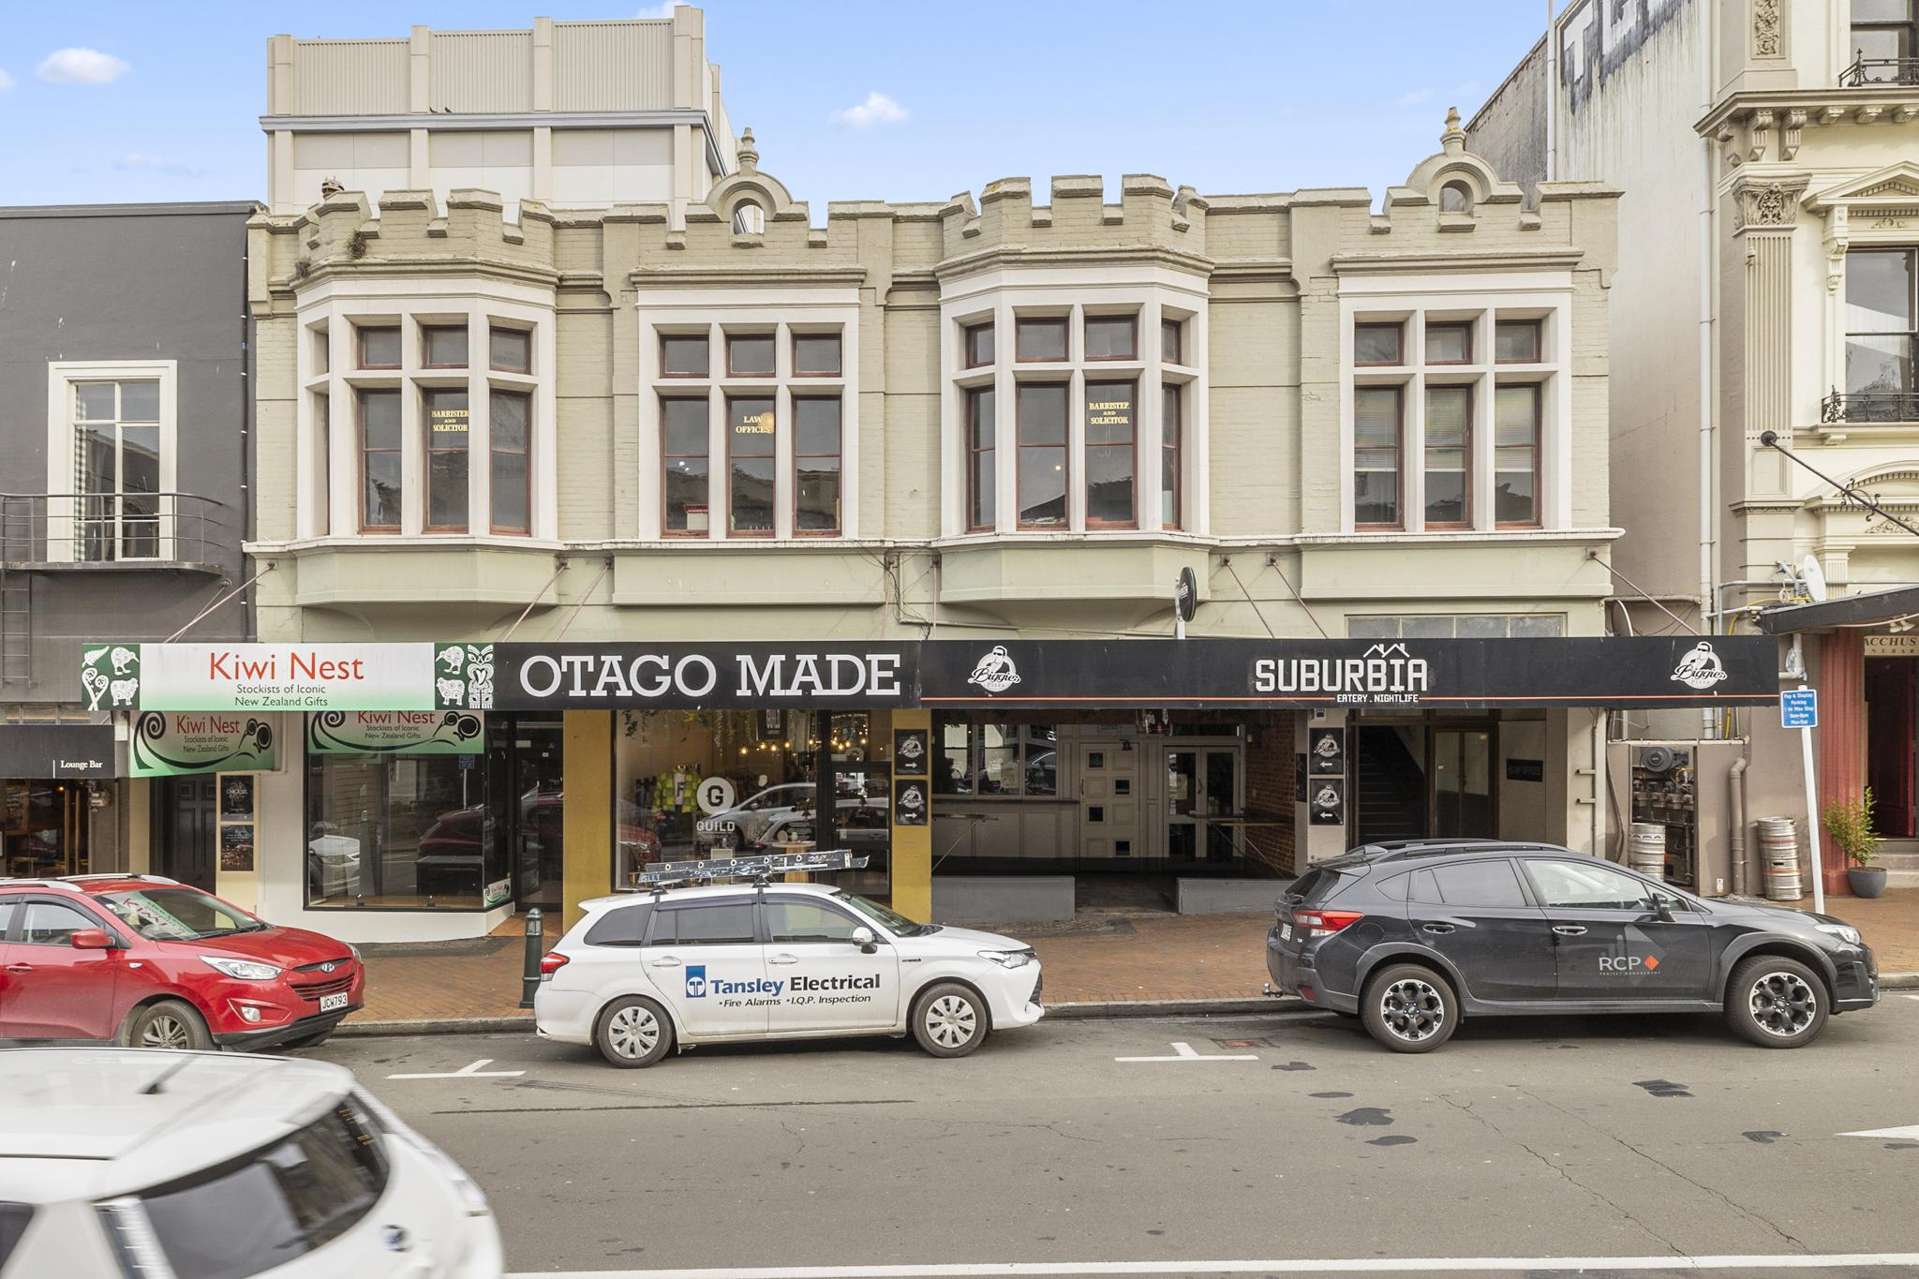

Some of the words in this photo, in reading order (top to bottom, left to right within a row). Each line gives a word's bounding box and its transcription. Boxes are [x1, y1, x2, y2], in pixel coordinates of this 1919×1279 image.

[210, 652, 275, 680] Kiwi
[290, 652, 364, 680] Nest
[519, 654, 716, 697] OTAGO
[735, 654, 900, 697] MADE
[1255, 659, 1428, 692] SUBURBIA
[236, 683, 280, 694] Stockists
[283, 683, 293, 694] of
[297, 683, 326, 694] Iconic
[234, 696, 258, 706] New
[262, 696, 301, 706] Zealand
[304, 696, 328, 706] Gifts
[1336, 694, 1368, 703] EATERY
[1374, 694, 1419, 703] NIGHTLIFE
[176, 714, 206, 734] Kiwi
[210, 715, 240, 734] Nest
[357, 711, 391, 723] Kiwi
[394, 711, 435, 723] Nest
[60, 760, 88, 770] Lounge
[89, 760, 103, 768] Bar
[707, 785, 723, 807] G
[696, 821, 735, 832] GUILD
[1599, 956, 1641, 971] RCP
[710, 978, 784, 996] Tansley
[790, 974, 880, 991] Electrical
[723, 999, 742, 1008] Fire
[745, 997, 781, 1007] Alarms
[818, 995, 871, 1005] Inspection
